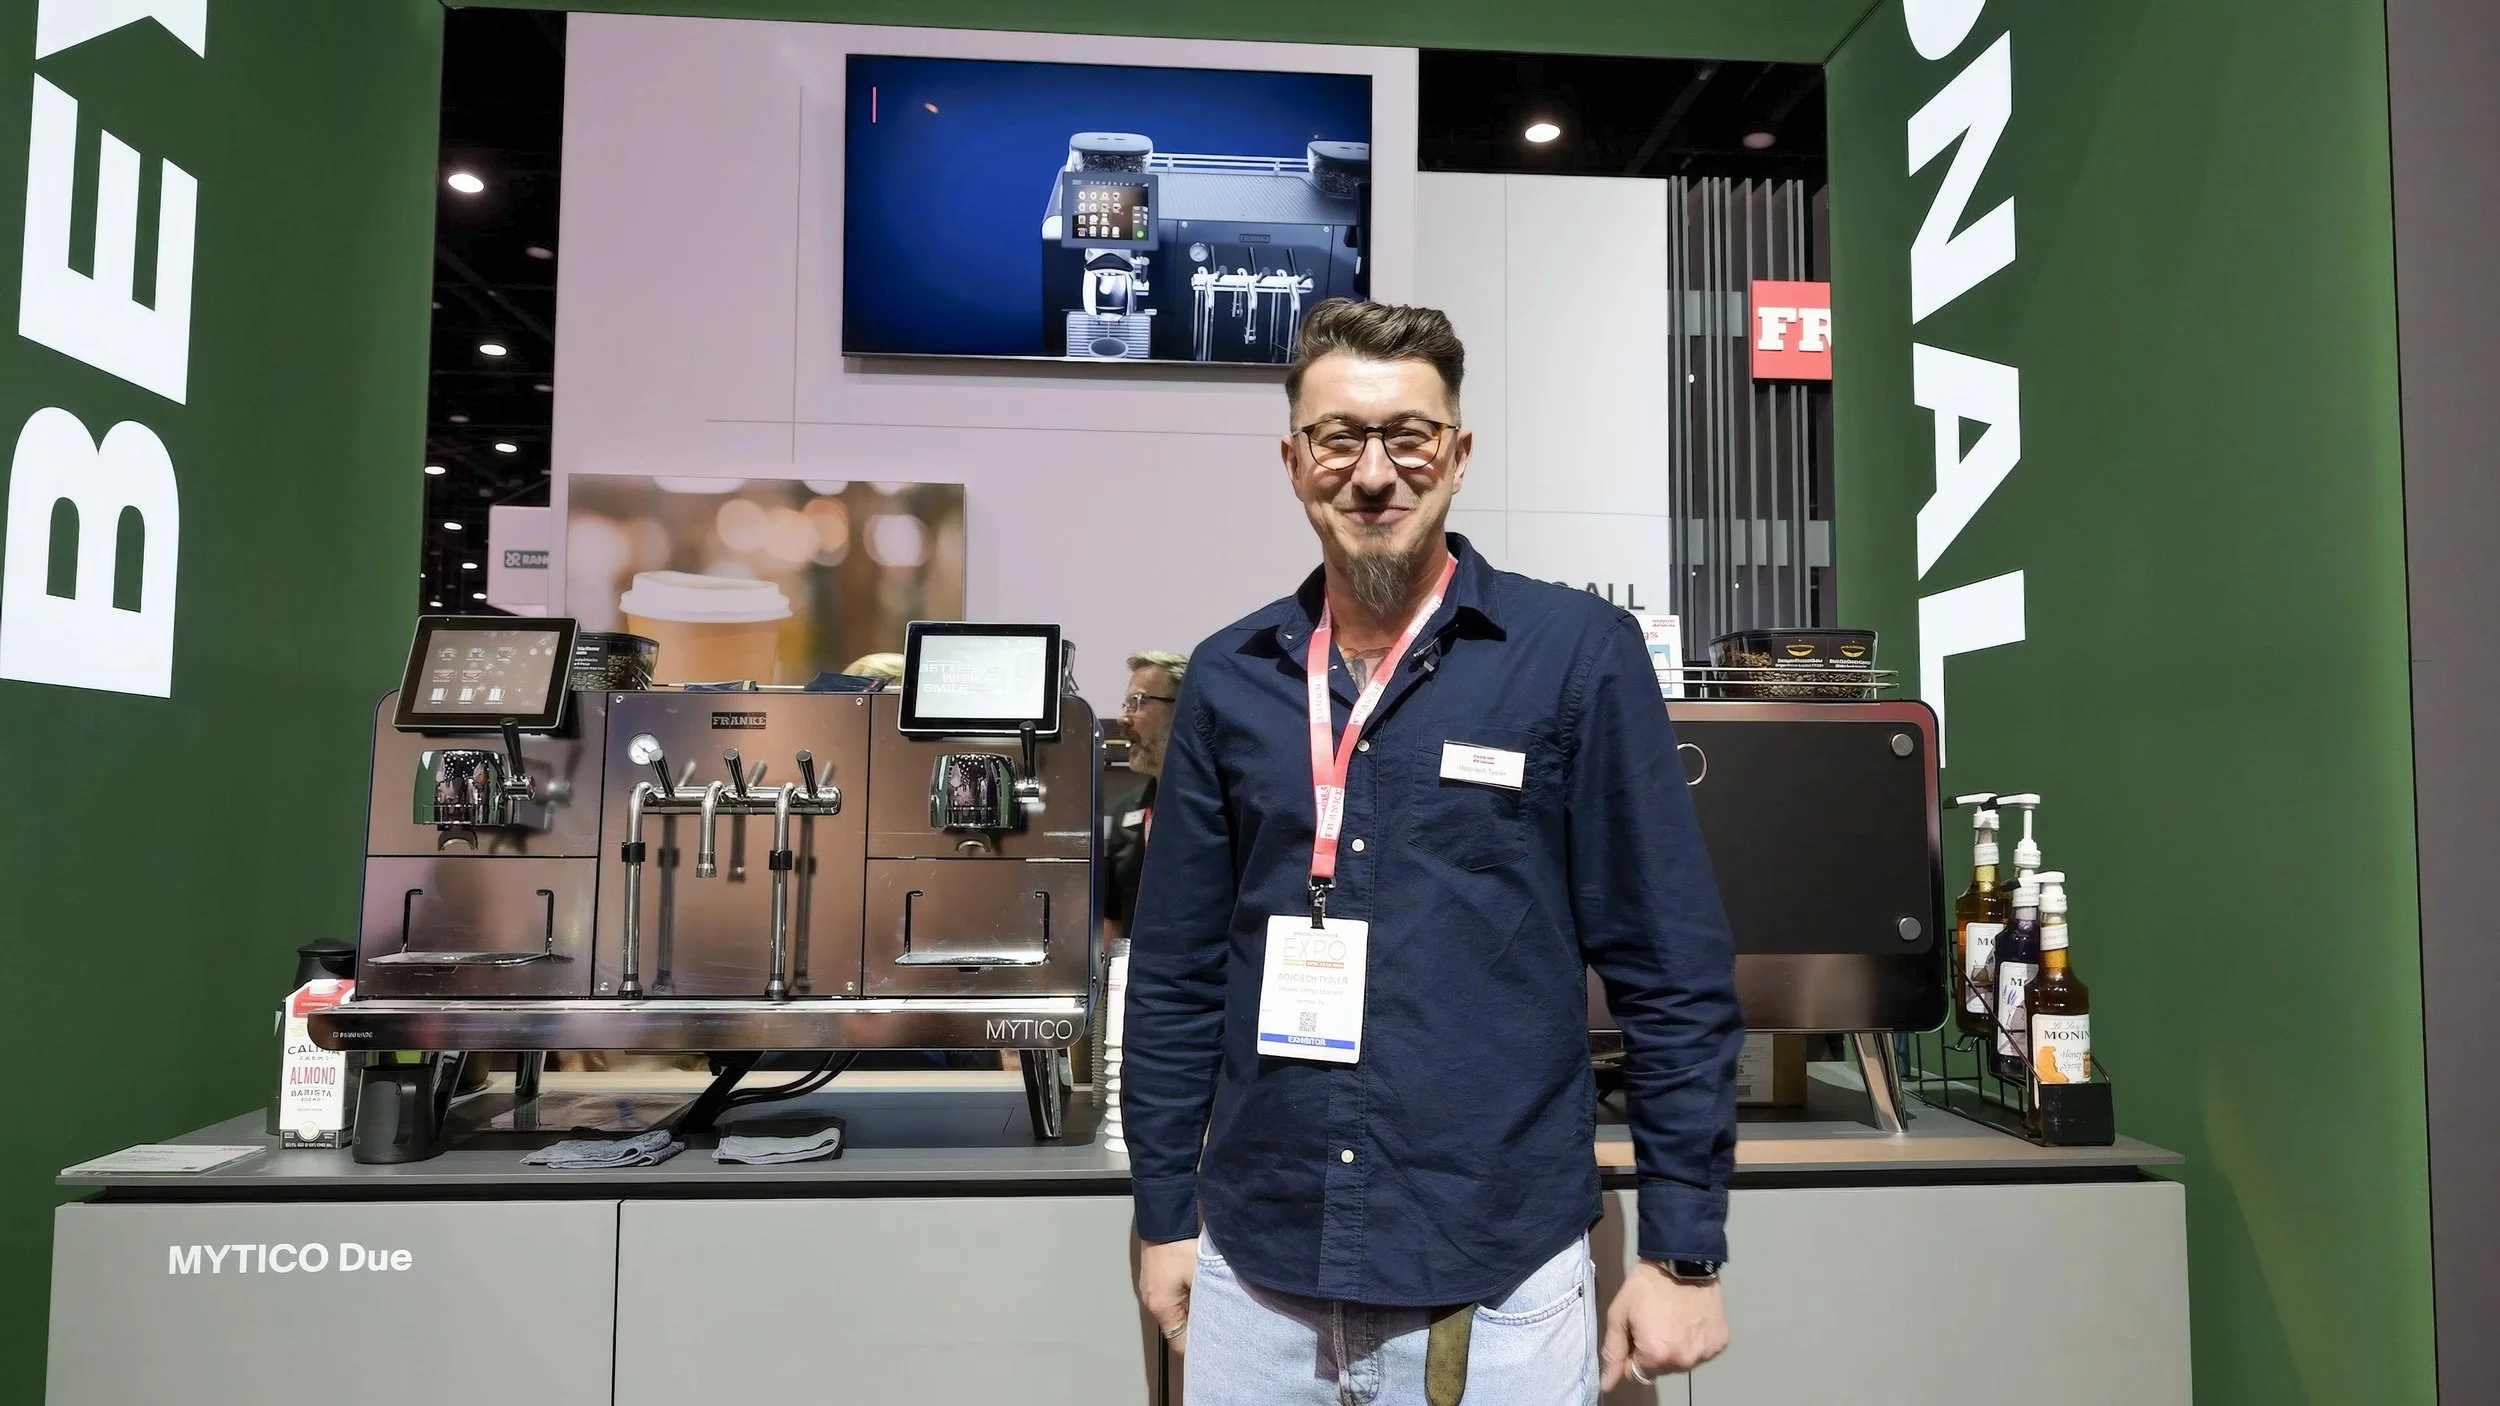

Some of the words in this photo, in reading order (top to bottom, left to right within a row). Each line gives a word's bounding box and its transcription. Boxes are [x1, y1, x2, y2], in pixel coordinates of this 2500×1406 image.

[0, 0, 207, 698] BE
[712, 716, 766, 726] FRANKE
[1284, 938, 1346, 961] EXPO
[986, 1019, 1073, 1040] MYTICO
[289, 1066, 336, 1086] ALMOND
[290, 1089, 332, 1098] BARISTA
[169, 1243, 329, 1275] MYTICO
[340, 1242, 413, 1272] Due
